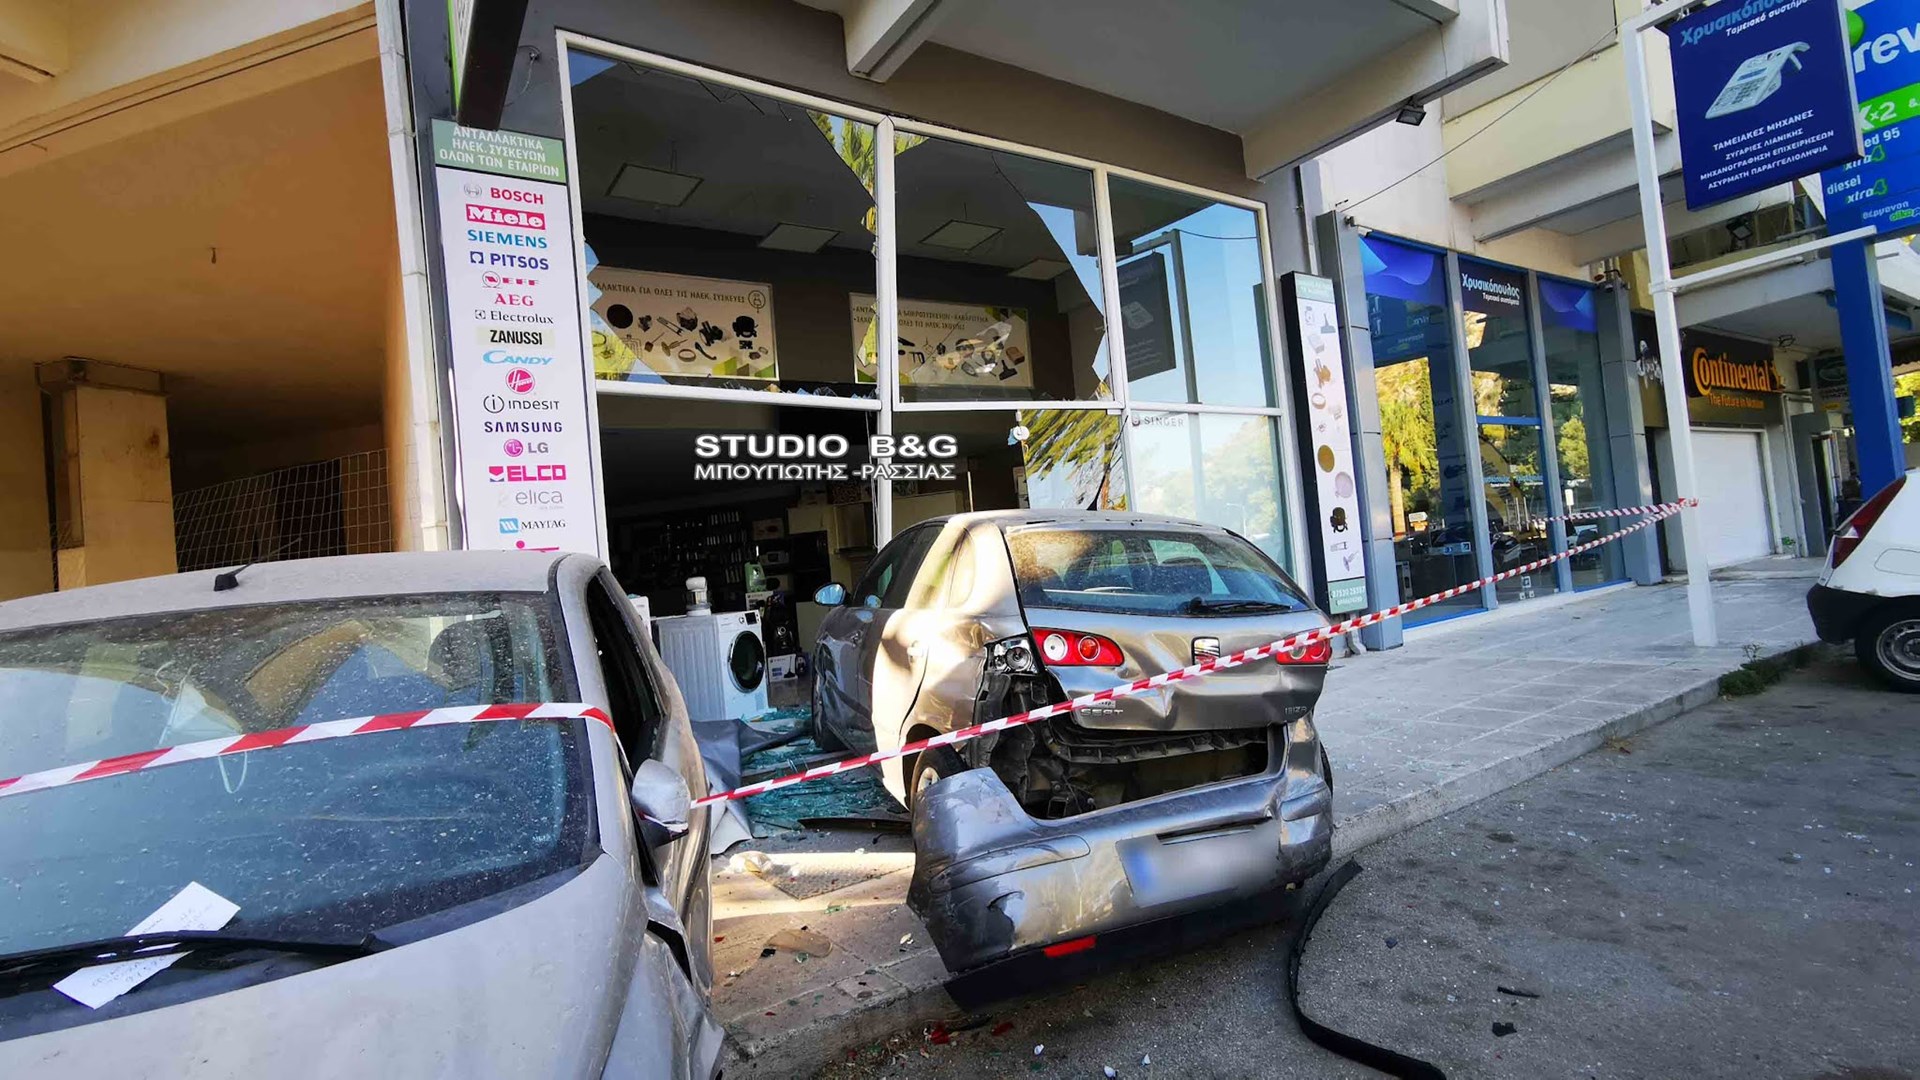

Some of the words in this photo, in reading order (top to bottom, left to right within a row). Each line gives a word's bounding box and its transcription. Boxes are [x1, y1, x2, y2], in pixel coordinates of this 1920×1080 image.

[1768, 0, 1807, 18] συστήμ
[453, 126, 544, 151] ΑΝΤΑΛΛΑΚΤΙΚΑ
[1713, 127, 1765, 151] ΤΑΜΕΙΑΚΕΣ
[1766, 109, 1814, 132] ΜΗΧΑΝΕΣ
[1883, 127, 1900, 142] 95
[452, 138, 487, 153] ΗΛΕΚ.
[489, 144, 546, 163] ΣΥΣΚΕΥΩΝ
[1725, 143, 1763, 160] ΖΥΓΑΡΙΕΣ
[1764, 128, 1804, 147] ΛΙΑΝΙΚΗΣ
[440, 149, 474, 164] ΟΛΩΝ
[478, 154, 503, 168] ΤΩΝ
[1700, 151, 1771, 180] ΜΗΧΑΝΟΓΡΑΦΗΣΗ
[1772, 129, 1834, 156] ΕΠΙΧΕΙΡΗΣΕΩΝ
[1708, 170, 1749, 190] ΑΣΥΡΜΑΤΗ
[1750, 145, 1828, 175] ΠΑΡΑΓΓΕΛΙΟΛΗΨΙΑ
[1826, 174, 1861, 195] diesel
[490, 187, 544, 205] BOSCH
[1846, 188, 1874, 204] xtra
[467, 206, 545, 228] Miele
[467, 229, 548, 249] SIEMENS
[489, 253, 550, 270] PITSOS
[1461, 273, 1520, 300] Χρυσικόπουλος
[494, 293, 534, 306] AEG
[490, 310, 554, 324] Electrolux
[489, 330, 543, 345] ZANUSSI
[1693, 347, 1771, 396] Continental
[484, 421, 563, 433] SAMSUNG
[1144, 416, 1185, 427] SINGER
[527, 442, 549, 454] LG
[506, 464, 567, 482] ELCO
[515, 489, 563, 505] elica
[521, 520, 566, 529] MAYTAG
